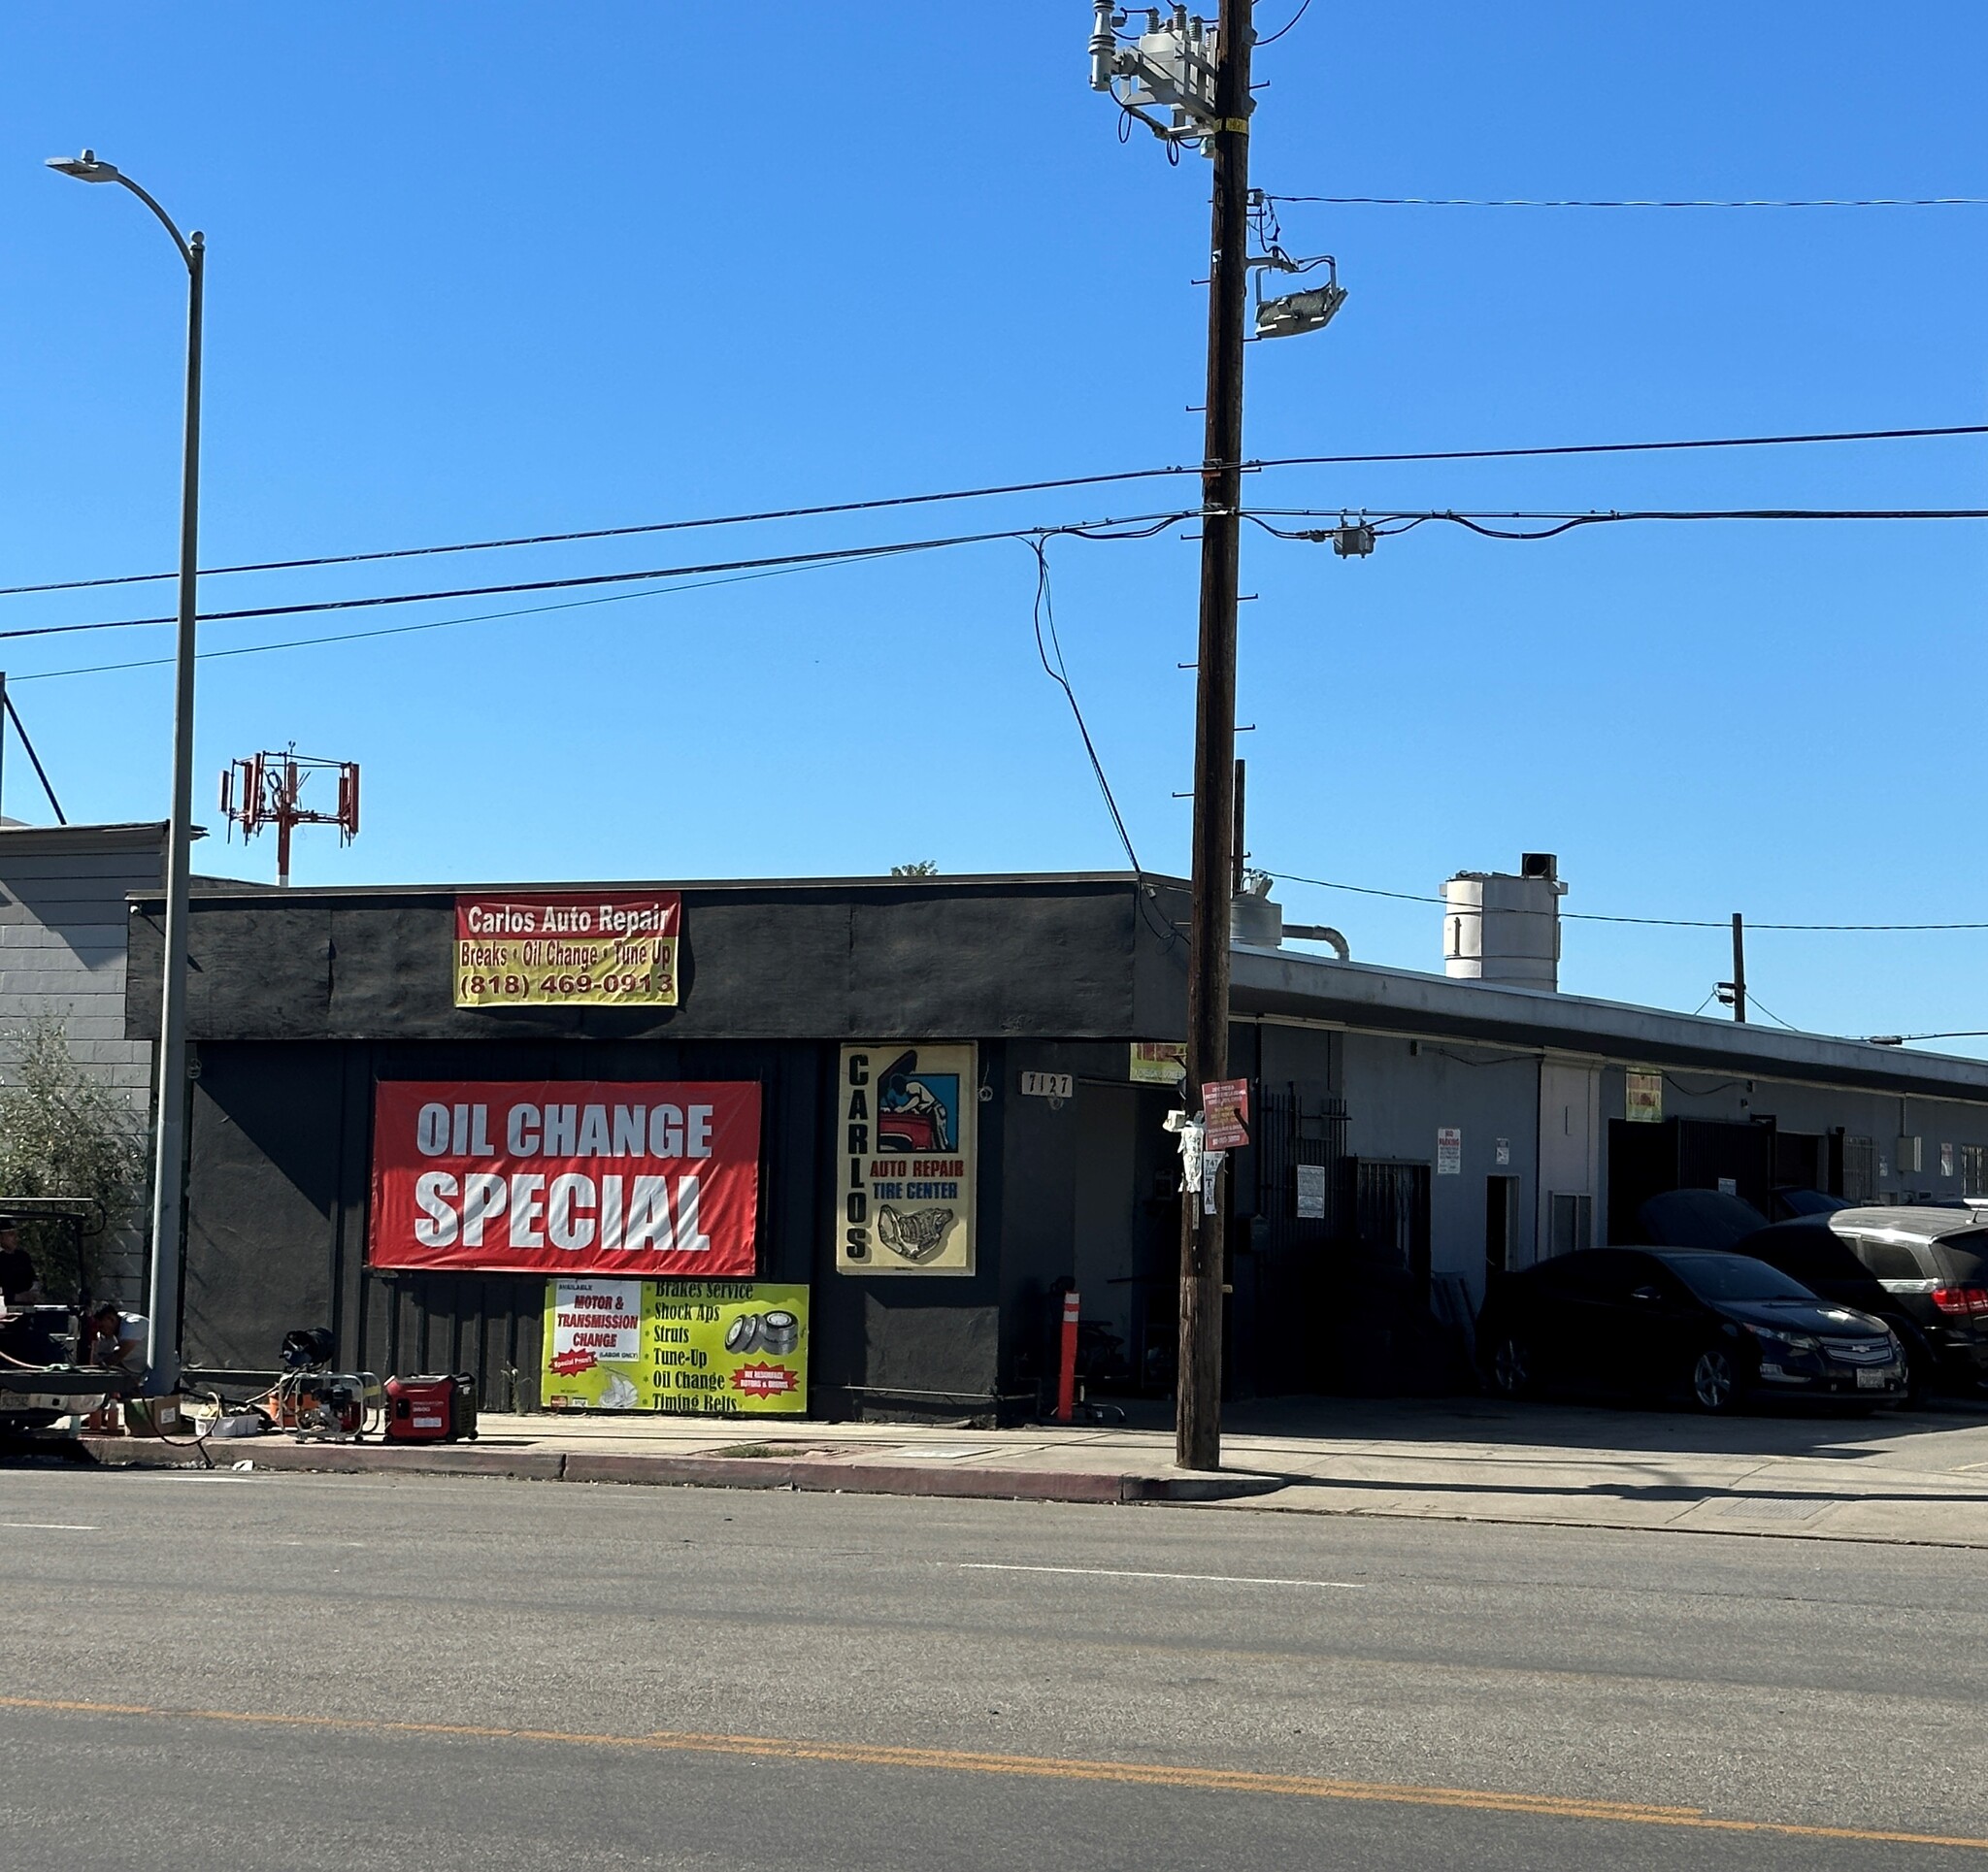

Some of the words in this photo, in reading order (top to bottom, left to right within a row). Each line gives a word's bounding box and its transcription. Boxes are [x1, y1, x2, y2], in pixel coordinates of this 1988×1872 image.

[468, 905, 535, 933] Carlos
[542, 905, 591, 933] Auto
[598, 903, 669, 936] Repair
[461, 941, 507, 967] Breaks
[523, 940, 542, 967] Oil
[547, 940, 598, 970] Change
[613, 939, 647, 966] Tune
[652, 941, 671, 969] Up
[460, 973, 530, 1000] (818)
[541, 973, 673, 995] 469-0913
[1029, 1073, 1068, 1092] 7127
[416, 1102, 494, 1157] OIL
[507, 1103, 713, 1159] CHANGE
[846, 1054, 869, 1259] CARLOS
[870, 1161, 907, 1177] AUTO
[912, 1160, 964, 1177] REPAIR
[873, 1182, 902, 1199] TIRE
[907, 1182, 957, 1199] CENTER
[414, 1171, 711, 1252] SPECIAL
[707, 1282, 753, 1299] Service
[575, 1296, 613, 1308] MOTOR
[614, 1296, 624, 1309] &
[654, 1302, 693, 1320] Shock
[557, 1313, 639, 1330] TRANSMISSION
[573, 1332, 617, 1348] CHANGE
[653, 1325, 689, 1343] Struts
[653, 1348, 708, 1368] Tune-Up
[653, 1370, 671, 1389] Oil
[675, 1371, 725, 1392] Change
